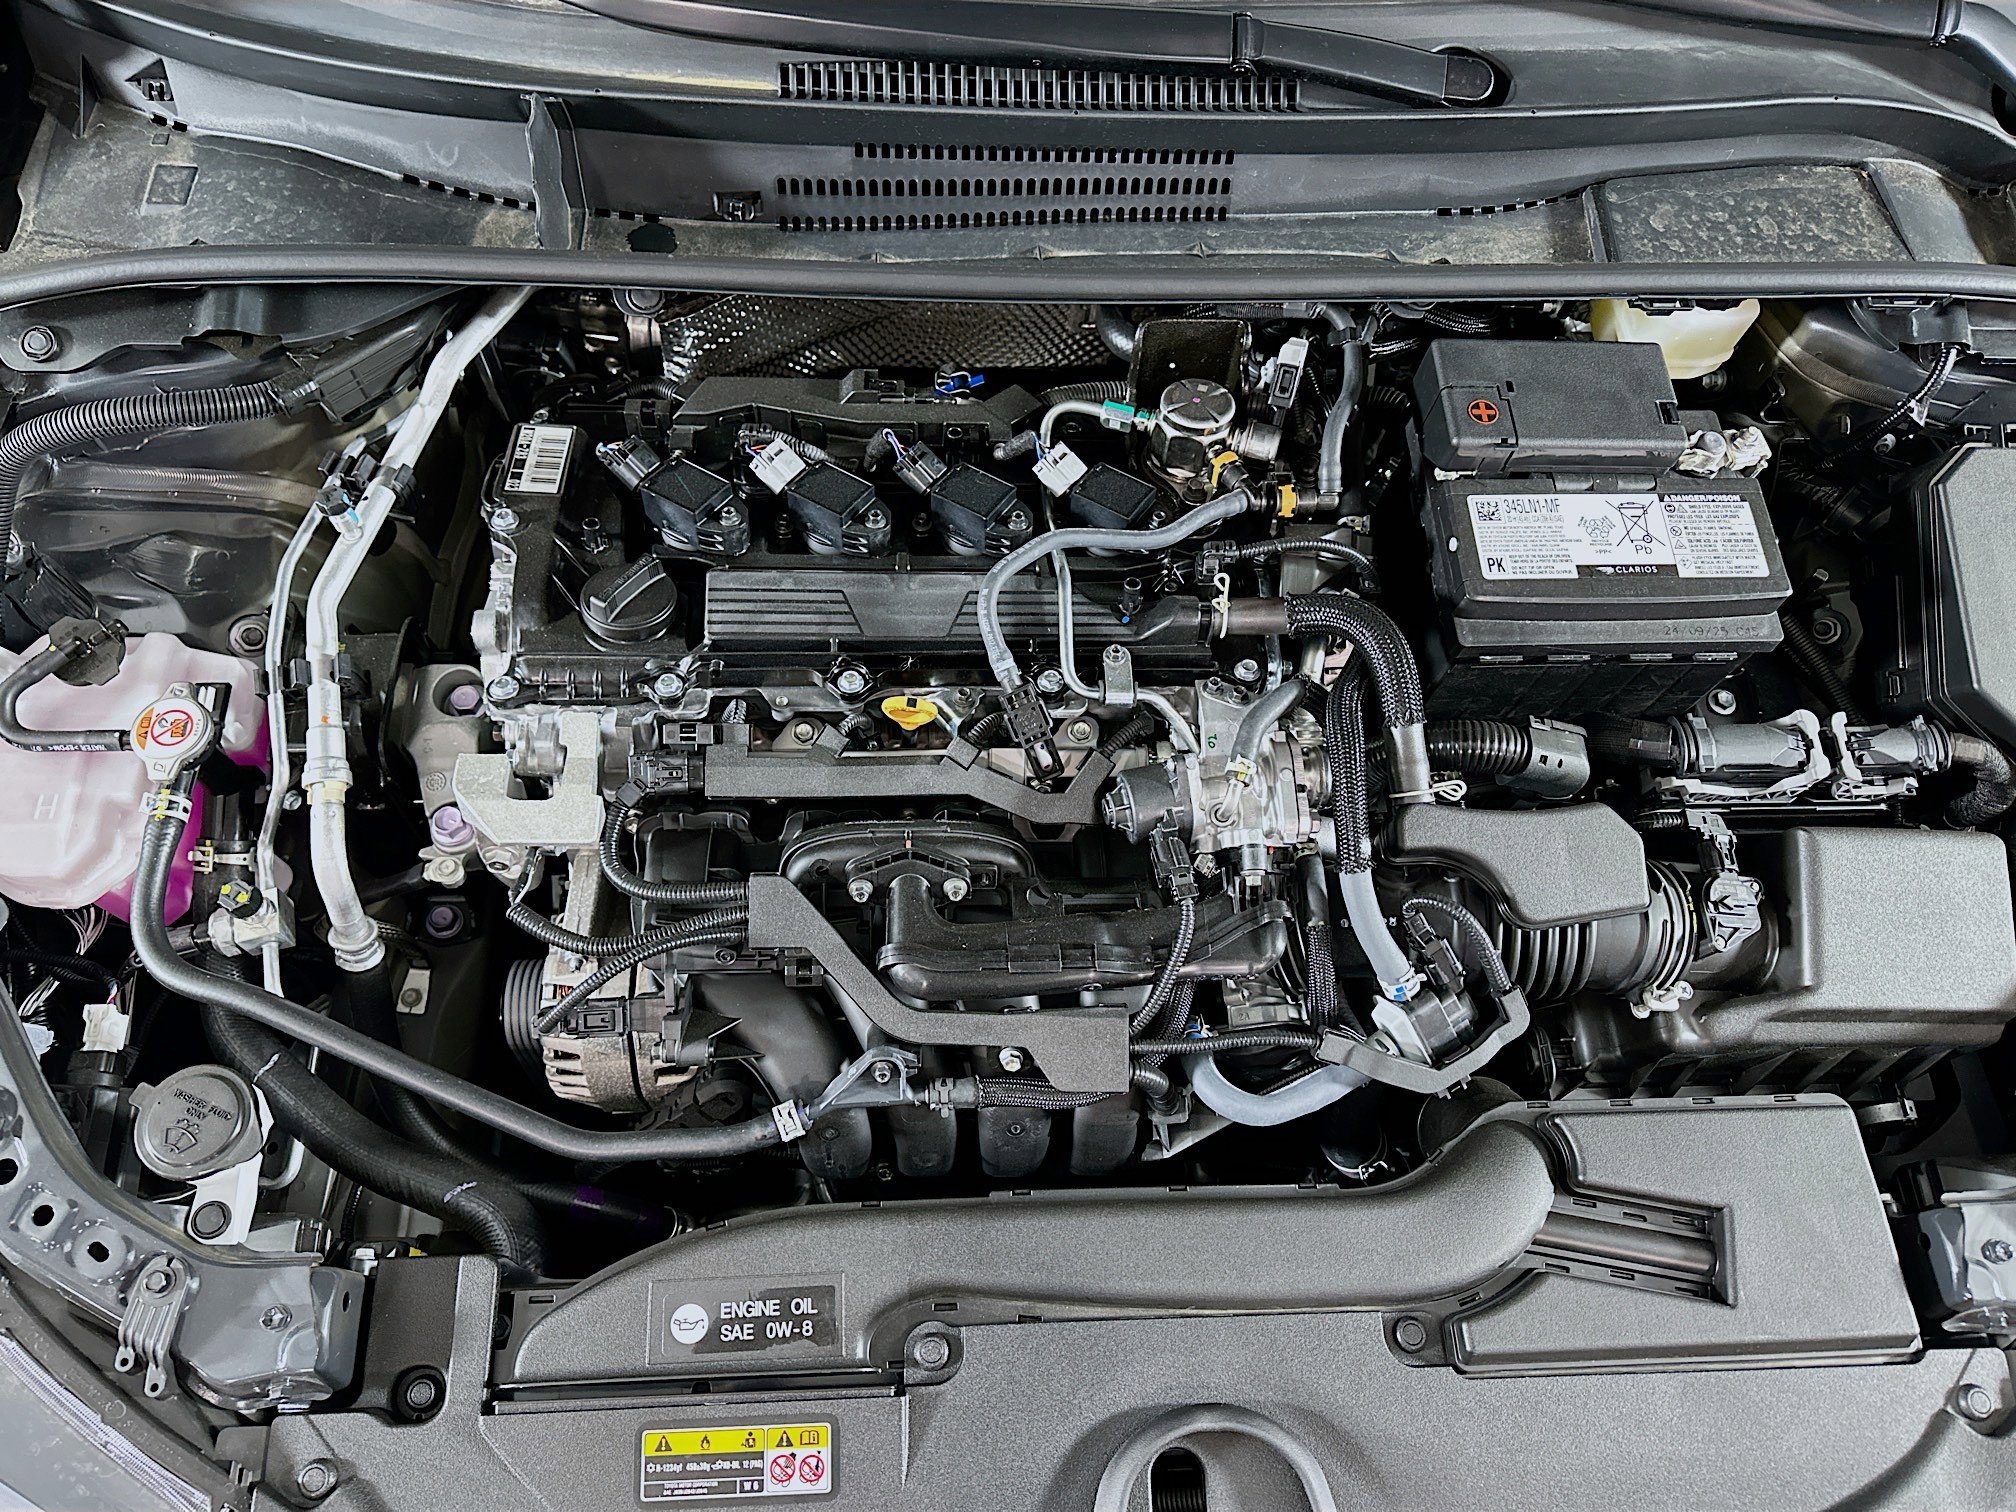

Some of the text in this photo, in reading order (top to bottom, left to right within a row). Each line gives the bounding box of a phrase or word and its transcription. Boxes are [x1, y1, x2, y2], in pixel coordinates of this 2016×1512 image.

[1503, 498, 1560, 514] 345LN1-MF
[1671, 494, 1741, 502] DANGER/POISON
[1635, 544, 1653, 555] Pb
[1487, 557, 1506, 573] PK
[1615, 565, 1658, 574] CLARIOS
[34, 793, 59, 820] H
[174, 1088, 232, 1121] WASHER FLUID
[186, 1106, 207, 1121] ONLY
[720, 1298, 818, 1319] ENGINE OIL
[720, 1321, 813, 1342] SAE 0W-8
